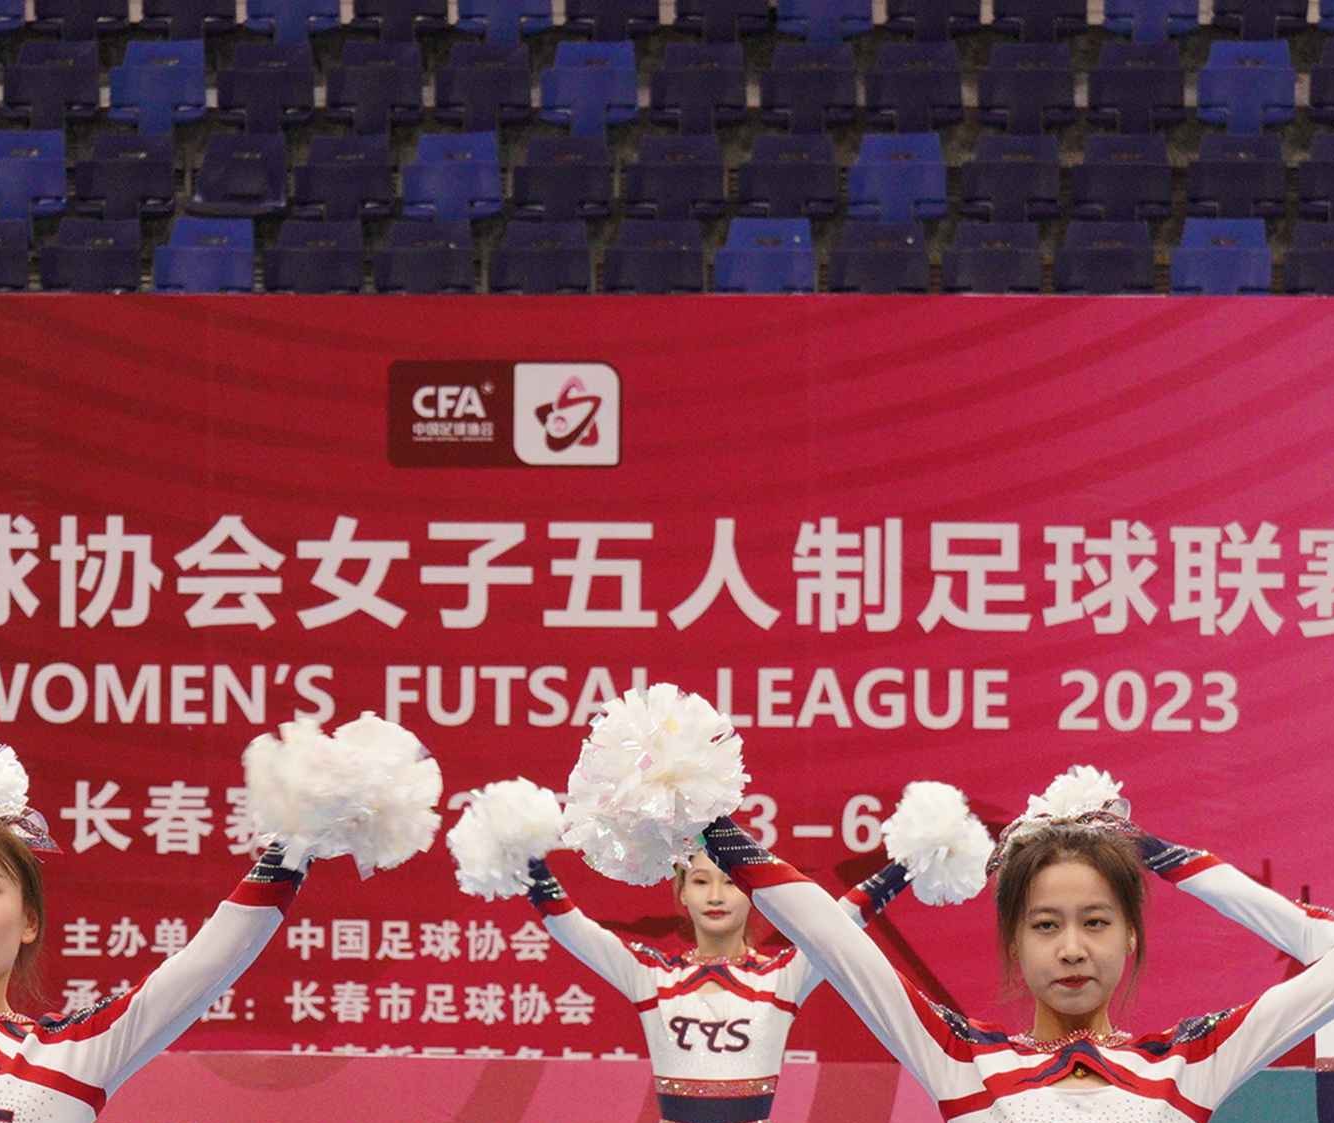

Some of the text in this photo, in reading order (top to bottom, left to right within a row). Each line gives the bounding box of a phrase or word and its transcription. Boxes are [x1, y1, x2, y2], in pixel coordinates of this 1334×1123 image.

[412, 386, 487, 418] CFA
[716, 667, 1010, 730] LEAGUE
[1058, 670, 1240, 733] 2023
[286, 919, 550, 962] 中国足球协会
[285, 980, 595, 1025] 长春市足球协会
[668, 1016, 751, 1053] TTS
